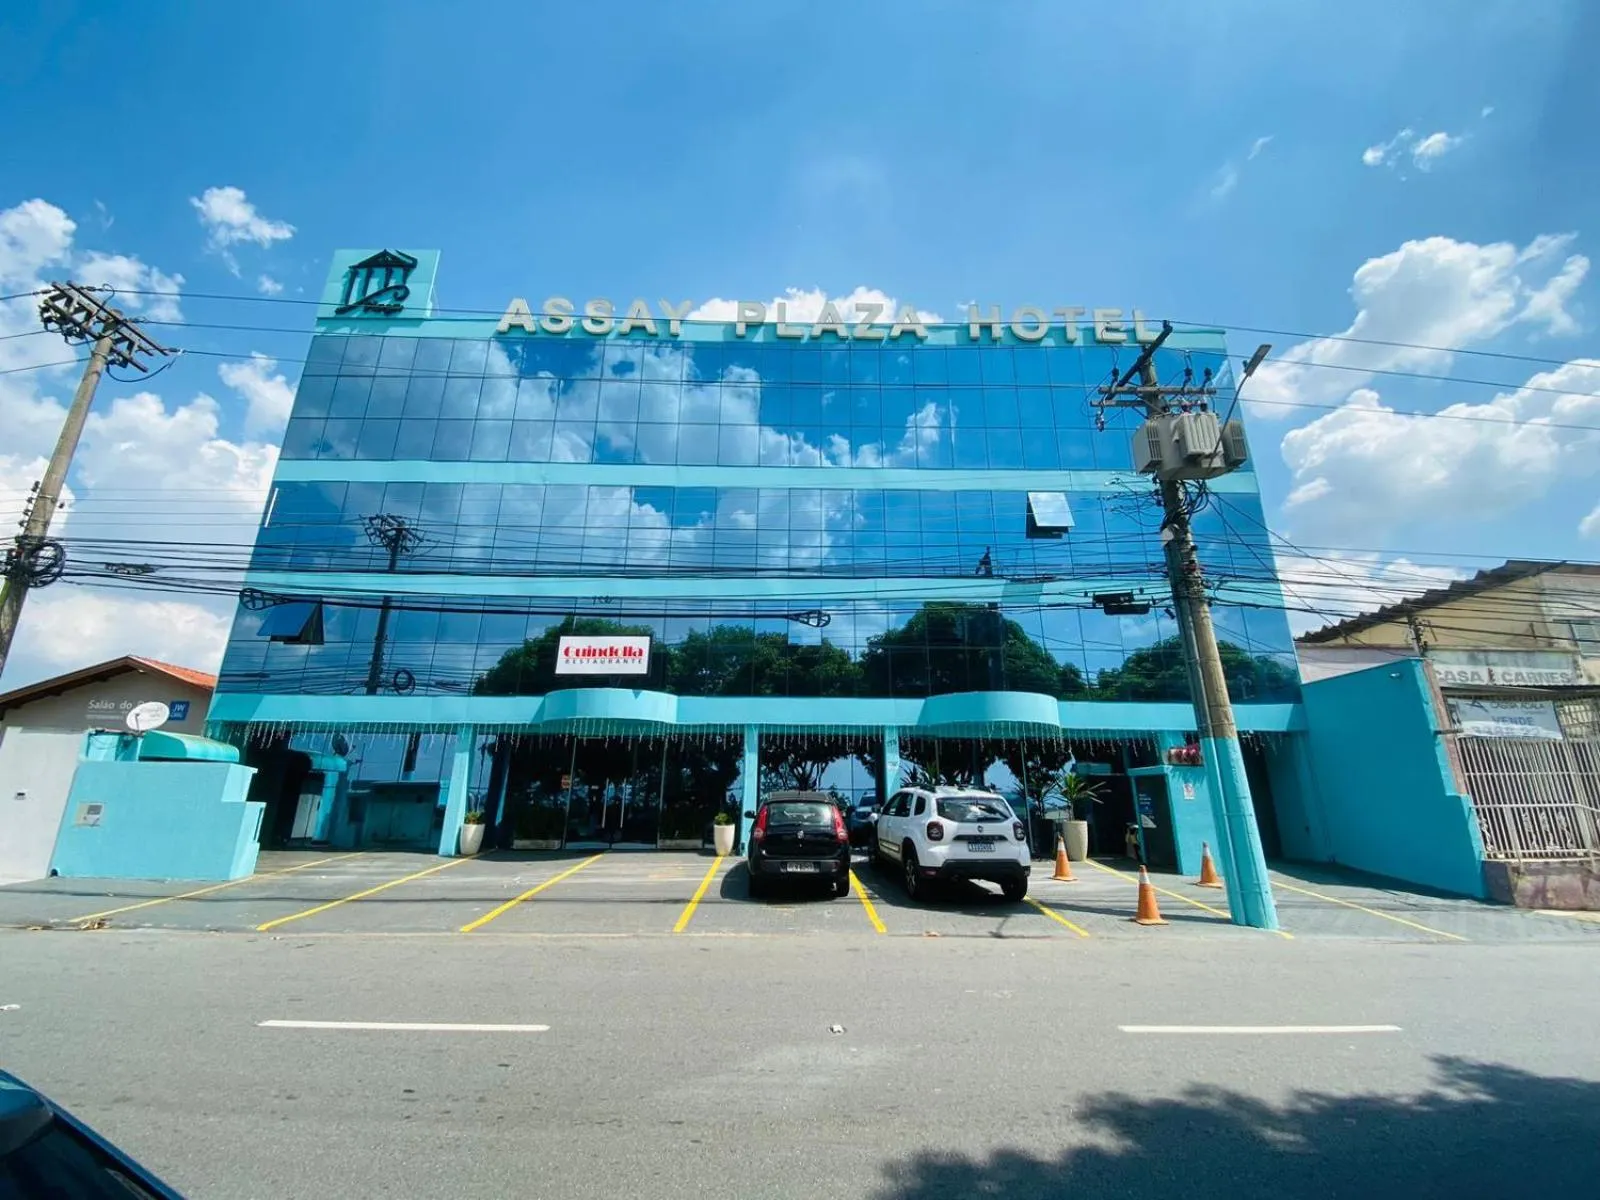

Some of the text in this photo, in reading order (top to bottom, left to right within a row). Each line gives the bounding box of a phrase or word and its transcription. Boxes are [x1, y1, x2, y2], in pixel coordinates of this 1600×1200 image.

[496, 297, 1159, 344] ASSAY PLAZA HOTEL
[1501, 671, 1572, 684] CARNES
[1491, 715, 1536, 726] VENDE
